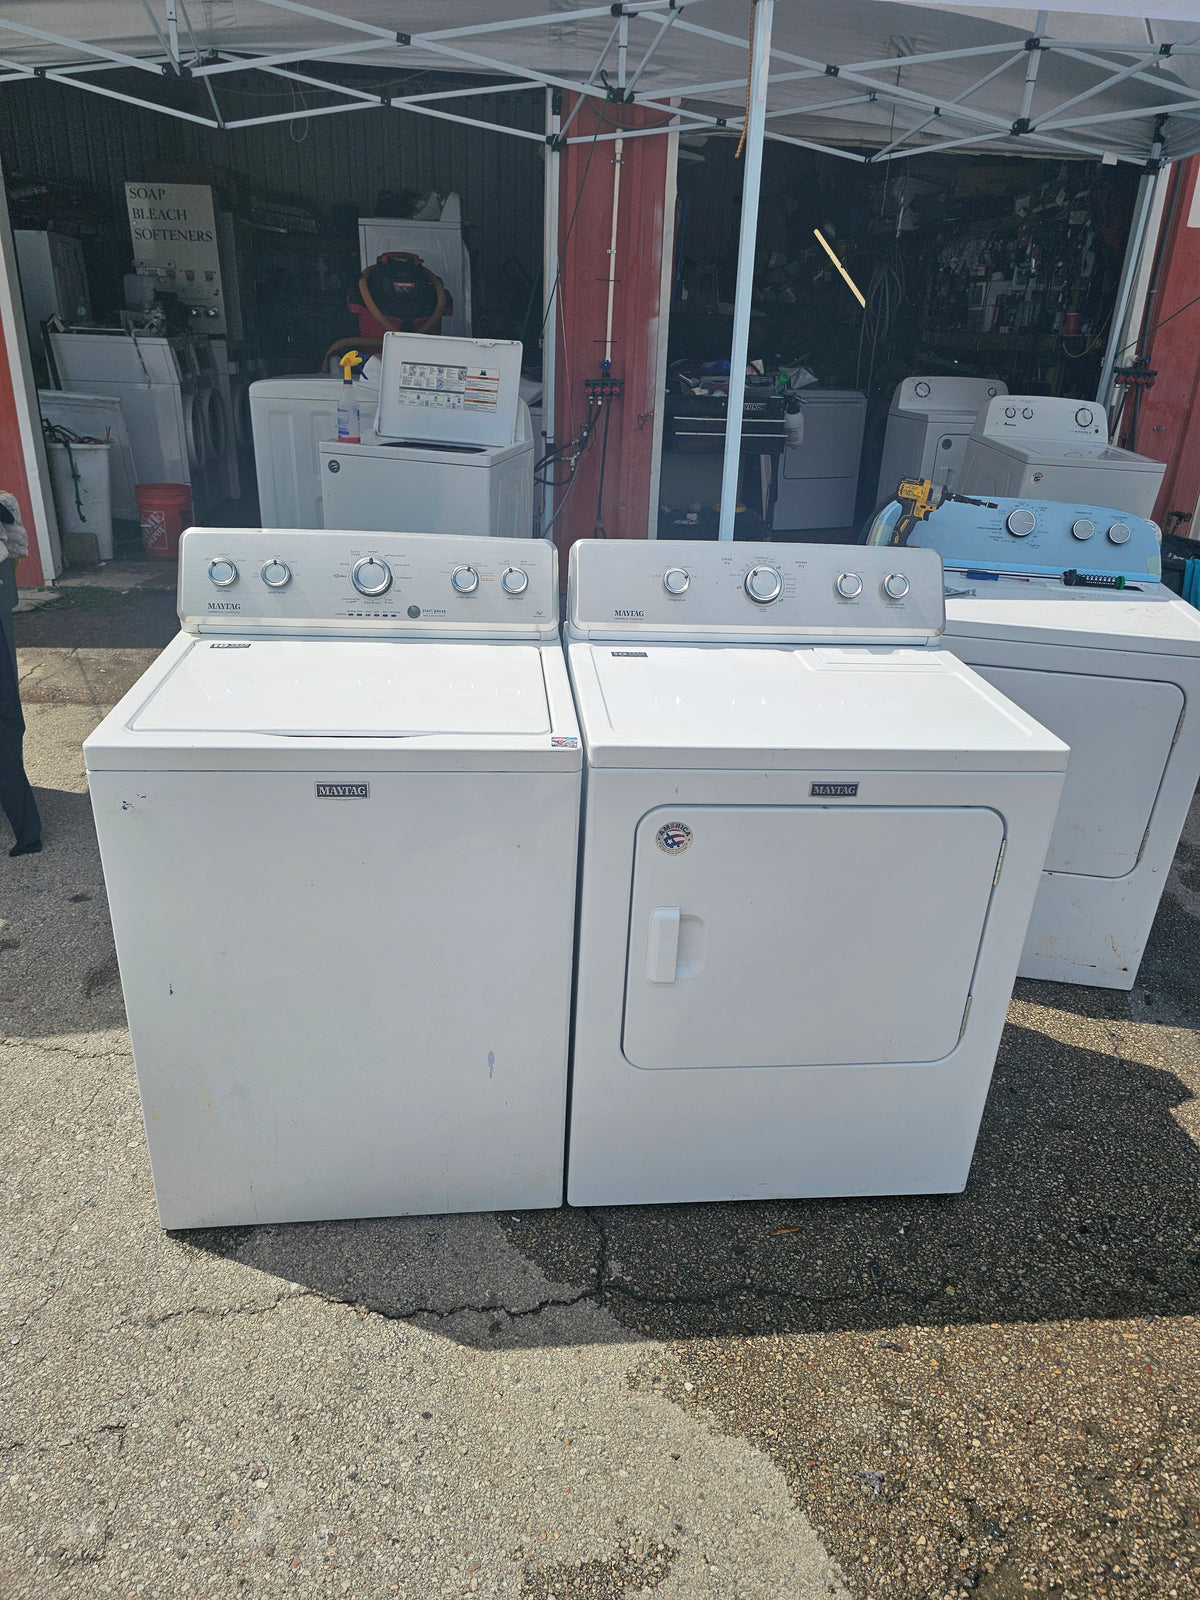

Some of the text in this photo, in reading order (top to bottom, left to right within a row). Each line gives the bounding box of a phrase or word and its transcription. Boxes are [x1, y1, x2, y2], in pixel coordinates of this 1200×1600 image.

[129, 187, 166, 201] SOAP
[132, 207, 187, 221] BLEACH
[134, 227, 213, 243] SOFTENERS
[207, 602, 241, 610] MAYTAG
[614, 609, 645, 617] MAYTAG
[318, 786, 366, 796] MAYTAG
[812, 786, 856, 795] MAYTAG
[658, 823, 692, 837] AMERICA
